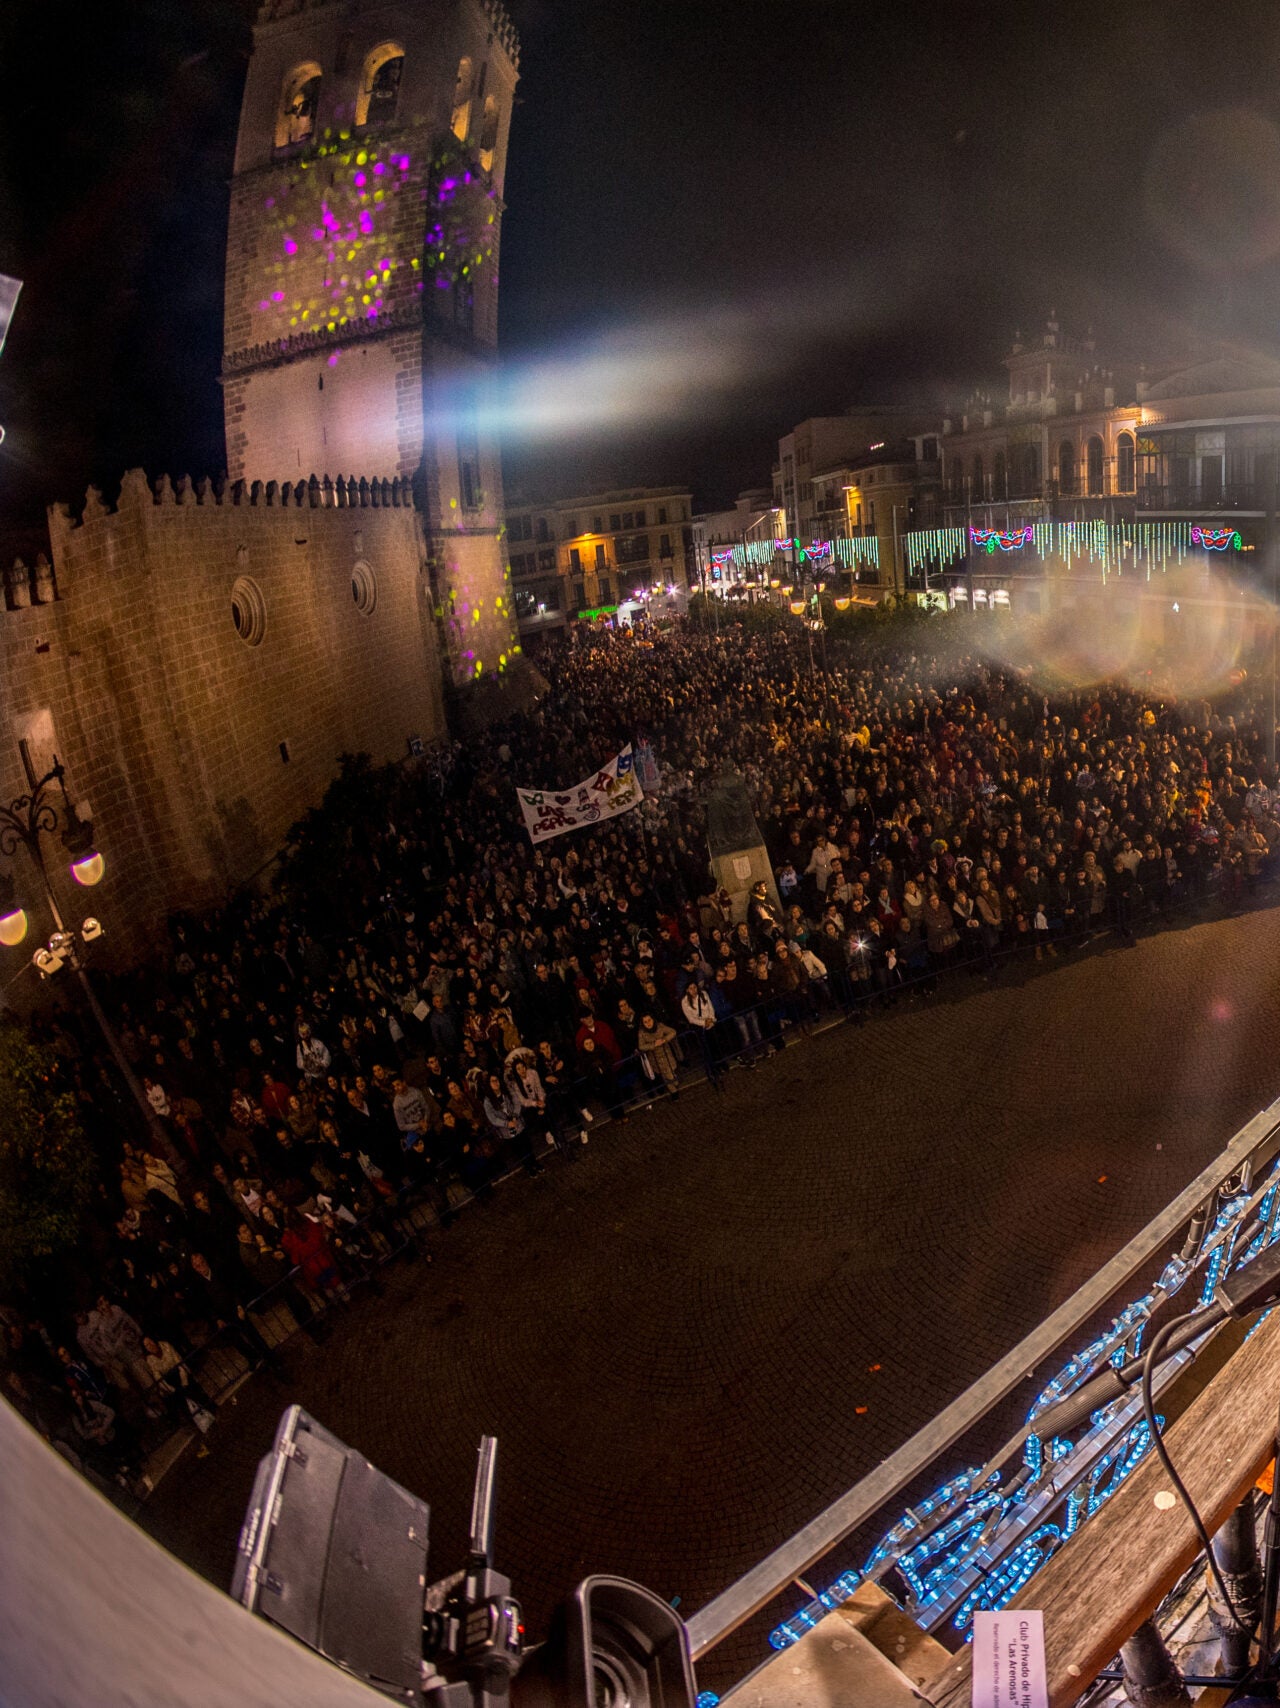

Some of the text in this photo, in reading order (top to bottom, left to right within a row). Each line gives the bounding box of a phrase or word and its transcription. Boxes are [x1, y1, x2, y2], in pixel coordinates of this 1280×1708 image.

[1020, 1621, 1029, 1641] Club
[1020, 1643, 1031, 1678] Privado
[1021, 1680, 1031, 1692] de
